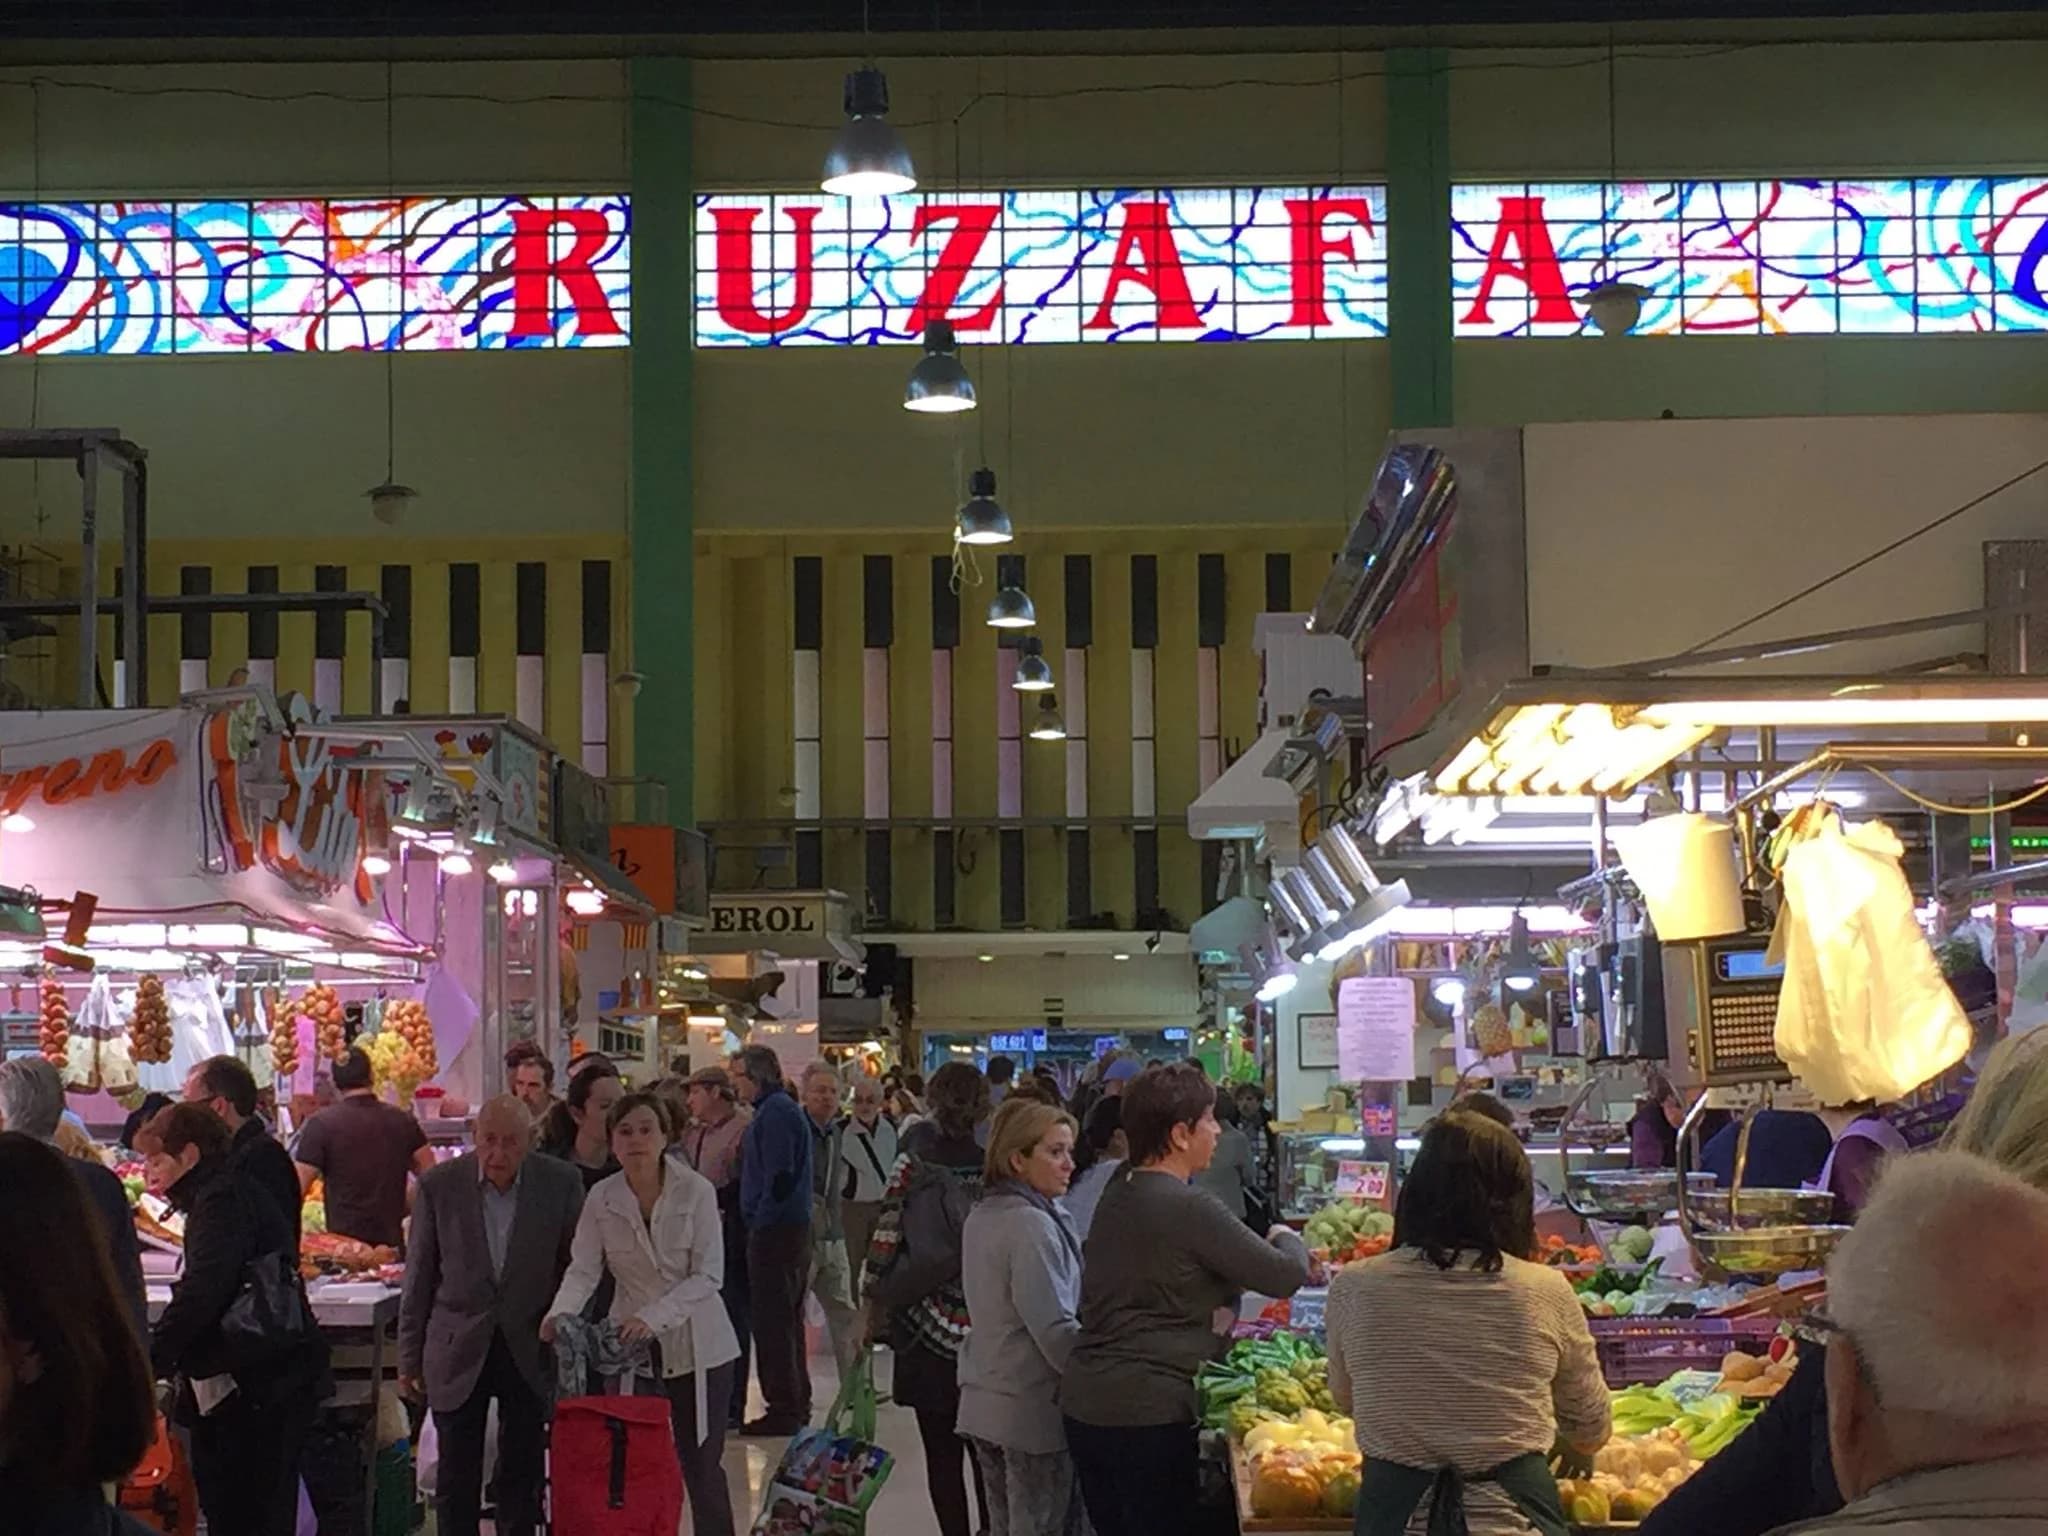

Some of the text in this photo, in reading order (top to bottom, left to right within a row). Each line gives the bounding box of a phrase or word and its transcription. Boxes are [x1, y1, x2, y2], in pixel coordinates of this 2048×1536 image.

[510, 196, 1581, 337] RUZAFA
[0, 738, 177, 815] reno
[690, 906, 814, 932] EROL
